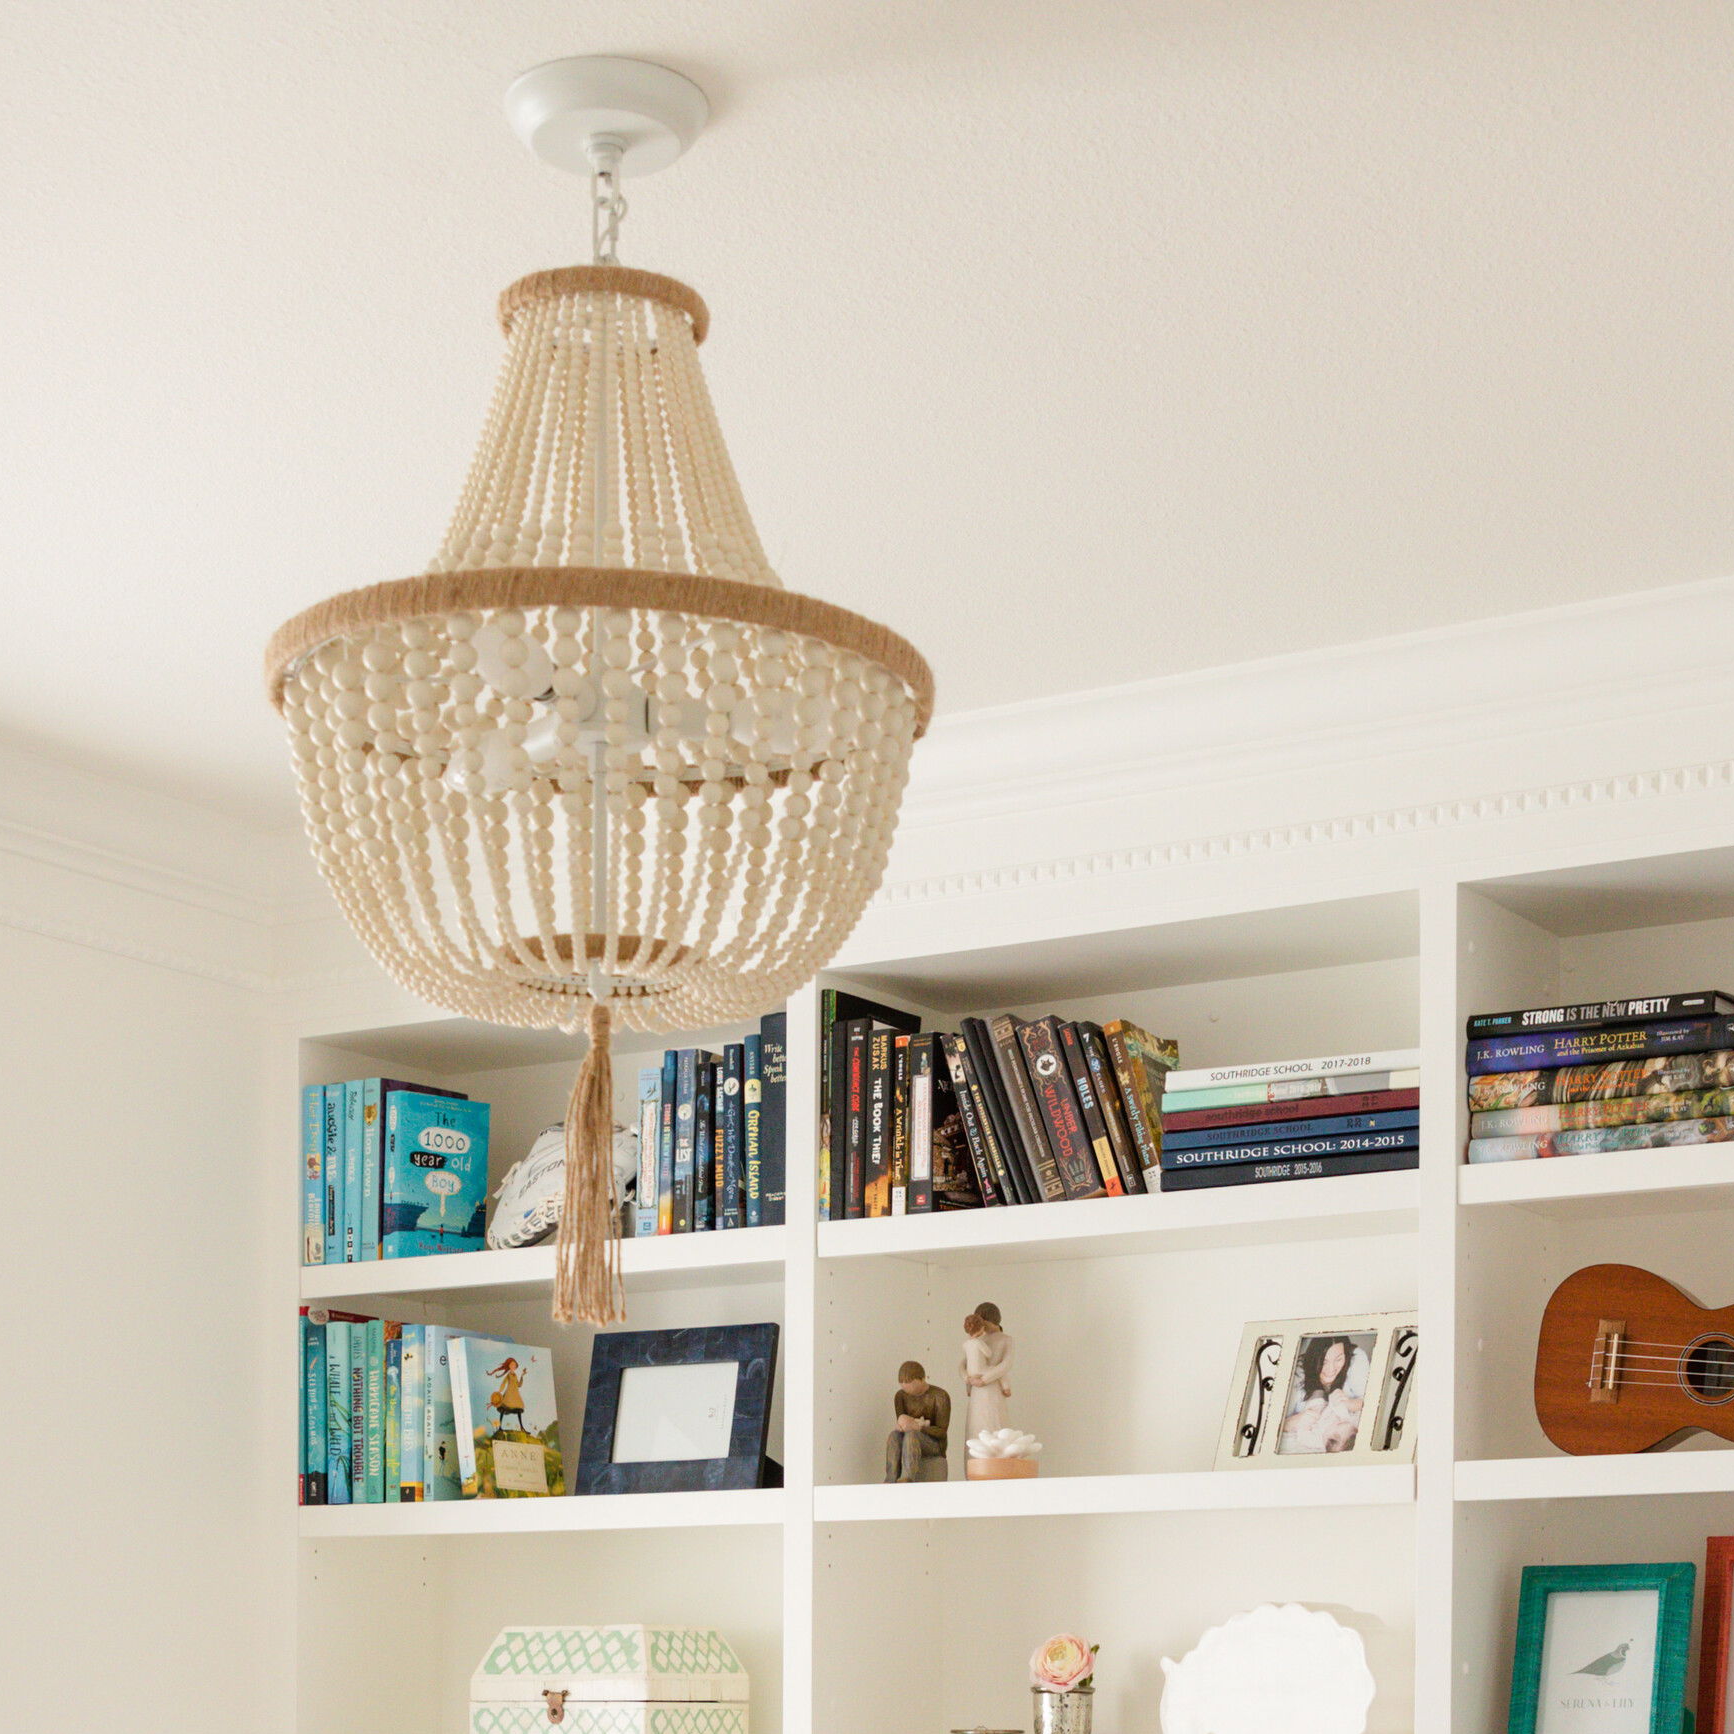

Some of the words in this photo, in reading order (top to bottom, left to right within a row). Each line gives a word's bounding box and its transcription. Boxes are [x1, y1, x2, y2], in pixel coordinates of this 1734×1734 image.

[1521, 1009, 1564, 1026] STRONG
[1566, 1008, 1577, 1021] IS
[1579, 1005, 1599, 1019] THE
[1627, 997, 1670, 1016] PRETTY
[872, 1036, 881, 1070] ZUSAK
[879, 1034, 888, 1070] MARKUS
[1495, 1044, 1545, 1058] ROWLING
[1554, 1035, 1595, 1050] HARRY
[1600, 1031, 1647, 1045] POTTER
[1210, 1065, 1270, 1082] SOUTHRIDGE
[1273, 1062, 1313, 1075] SCHOOL
[1321, 1056, 1371, 1070] 2017-2018
[872, 1077, 883, 1098] THE
[1077, 1076, 1095, 1109] HOLES
[435, 1112, 456, 1127] The
[872, 1101, 885, 1133] BOOK
[1043, 1084, 1074, 1158] WILDWOOD
[365, 1128, 375, 1158] lion
[715, 1129, 724, 1161] FUZZY
[871, 1134, 883, 1165] THIEF
[1175, 1145, 1269, 1165] SOUTHRIDGE
[1273, 1141, 1337, 1155] SCHOOL:
[1340, 1135, 1404, 1150] 2014-2015
[413, 1153, 441, 1167] year
[715, 1163, 724, 1187] MUD
[365, 1160, 375, 1198] down
[353, 1367, 365, 1412] NOTHING
[353, 1415, 364, 1435] BUT
[353, 1437, 365, 1483] TROUBLE
[369, 1435, 381, 1477] SEASON
